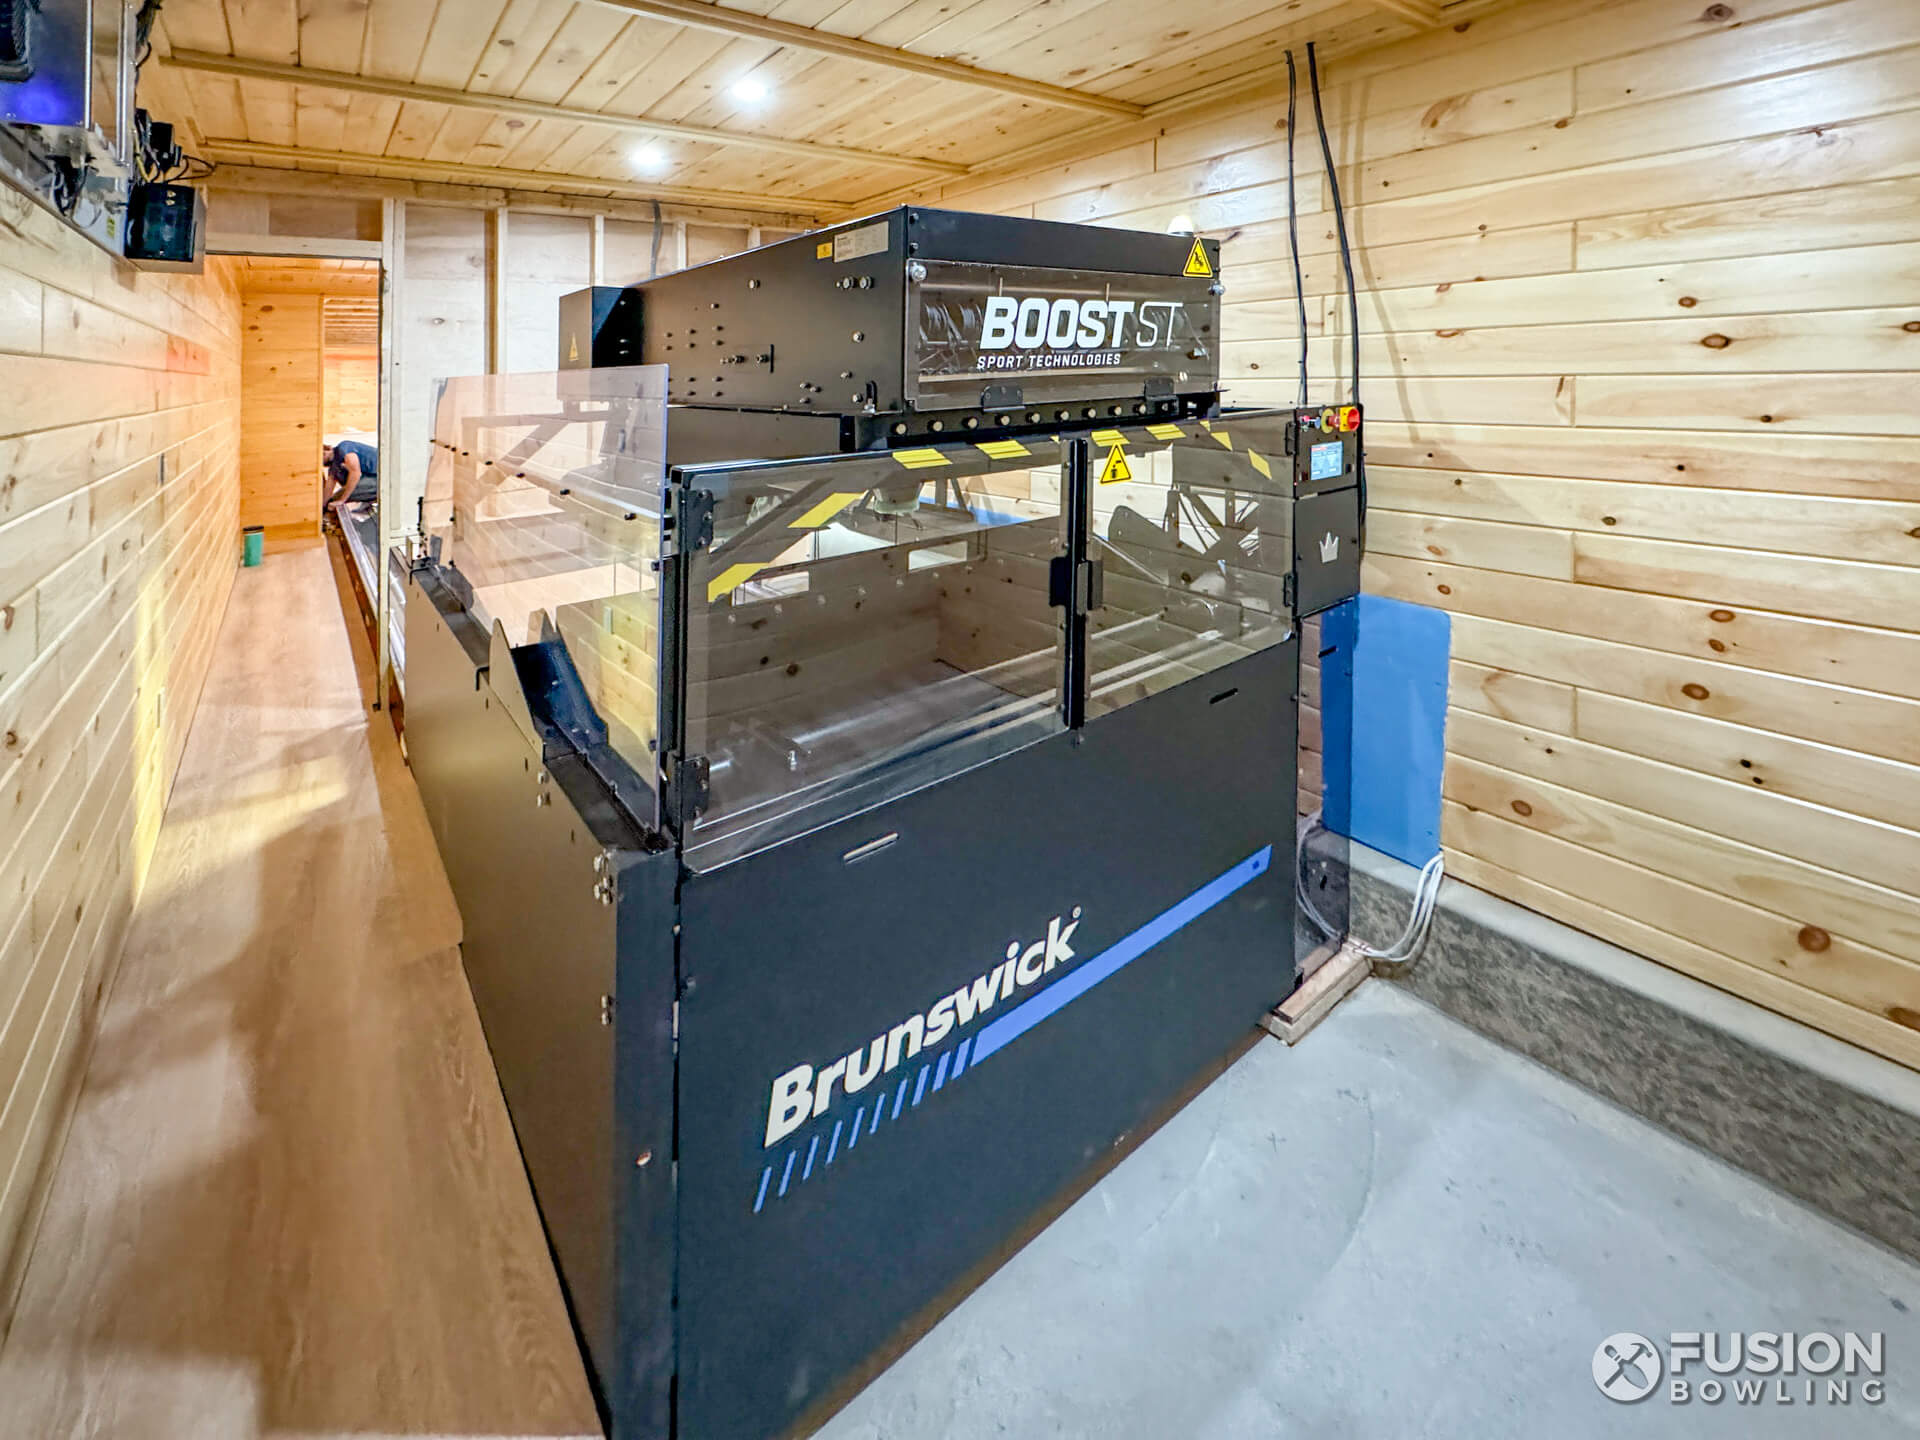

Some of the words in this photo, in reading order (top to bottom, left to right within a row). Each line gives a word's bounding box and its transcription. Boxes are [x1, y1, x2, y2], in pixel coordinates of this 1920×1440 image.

[980, 296, 1134, 350] BOOST
[1136, 301, 1184, 348] ST
[977, 354, 1023, 369] SPORT
[1028, 353, 1121, 367] TECHNOLOGIES
[764, 913, 1081, 1148] Brunswick
